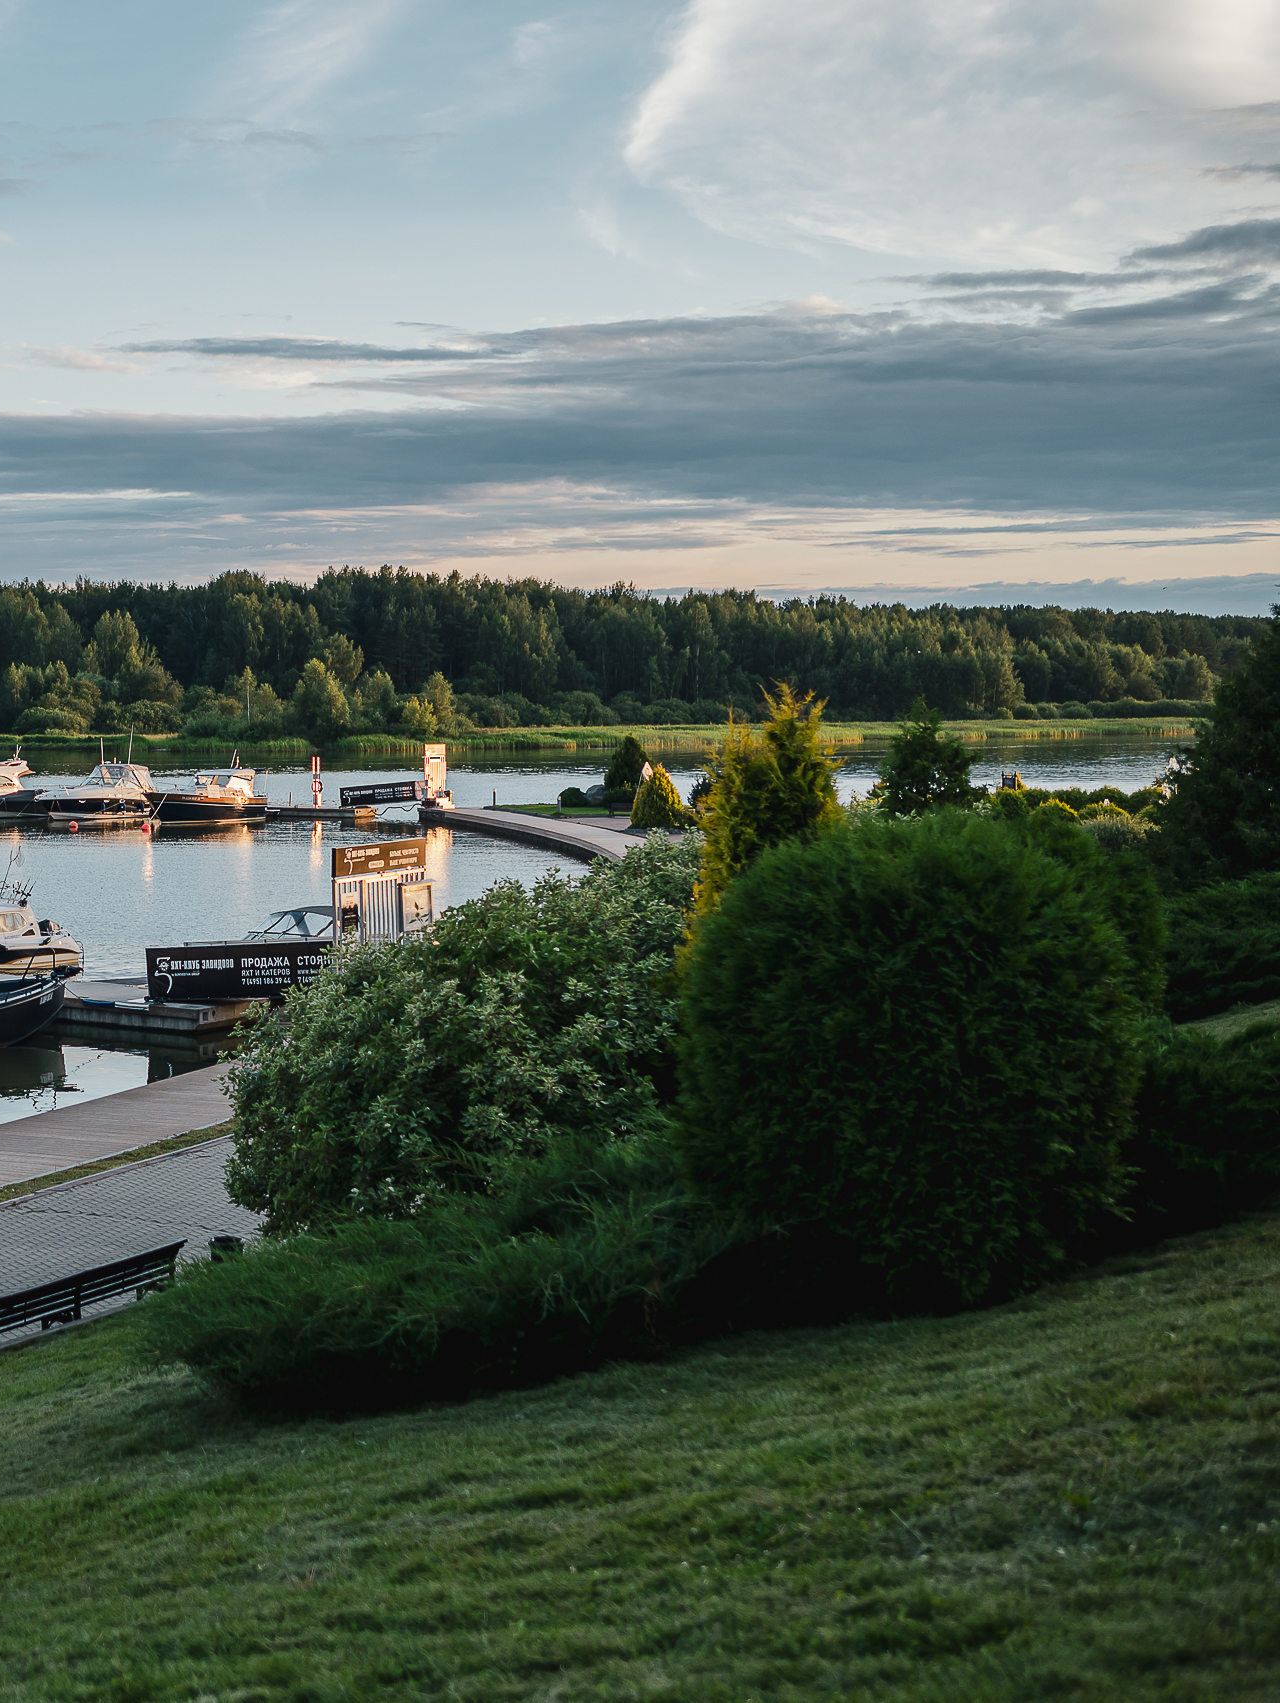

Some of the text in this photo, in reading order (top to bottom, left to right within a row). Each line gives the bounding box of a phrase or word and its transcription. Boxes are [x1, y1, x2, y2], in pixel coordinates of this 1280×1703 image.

[170, 958, 234, 971] ЯХТ-КЛУБ ЗАВИДОВО
[241, 956, 290, 969] ПРОДАЖА
[241, 969, 253, 977] ЯХТ
[261, 968, 291, 976] КАТЕРОВ
[246, 977, 262, 985] (495)
[263, 977, 274, 985] 186
[297, 976, 302, 984] 7
